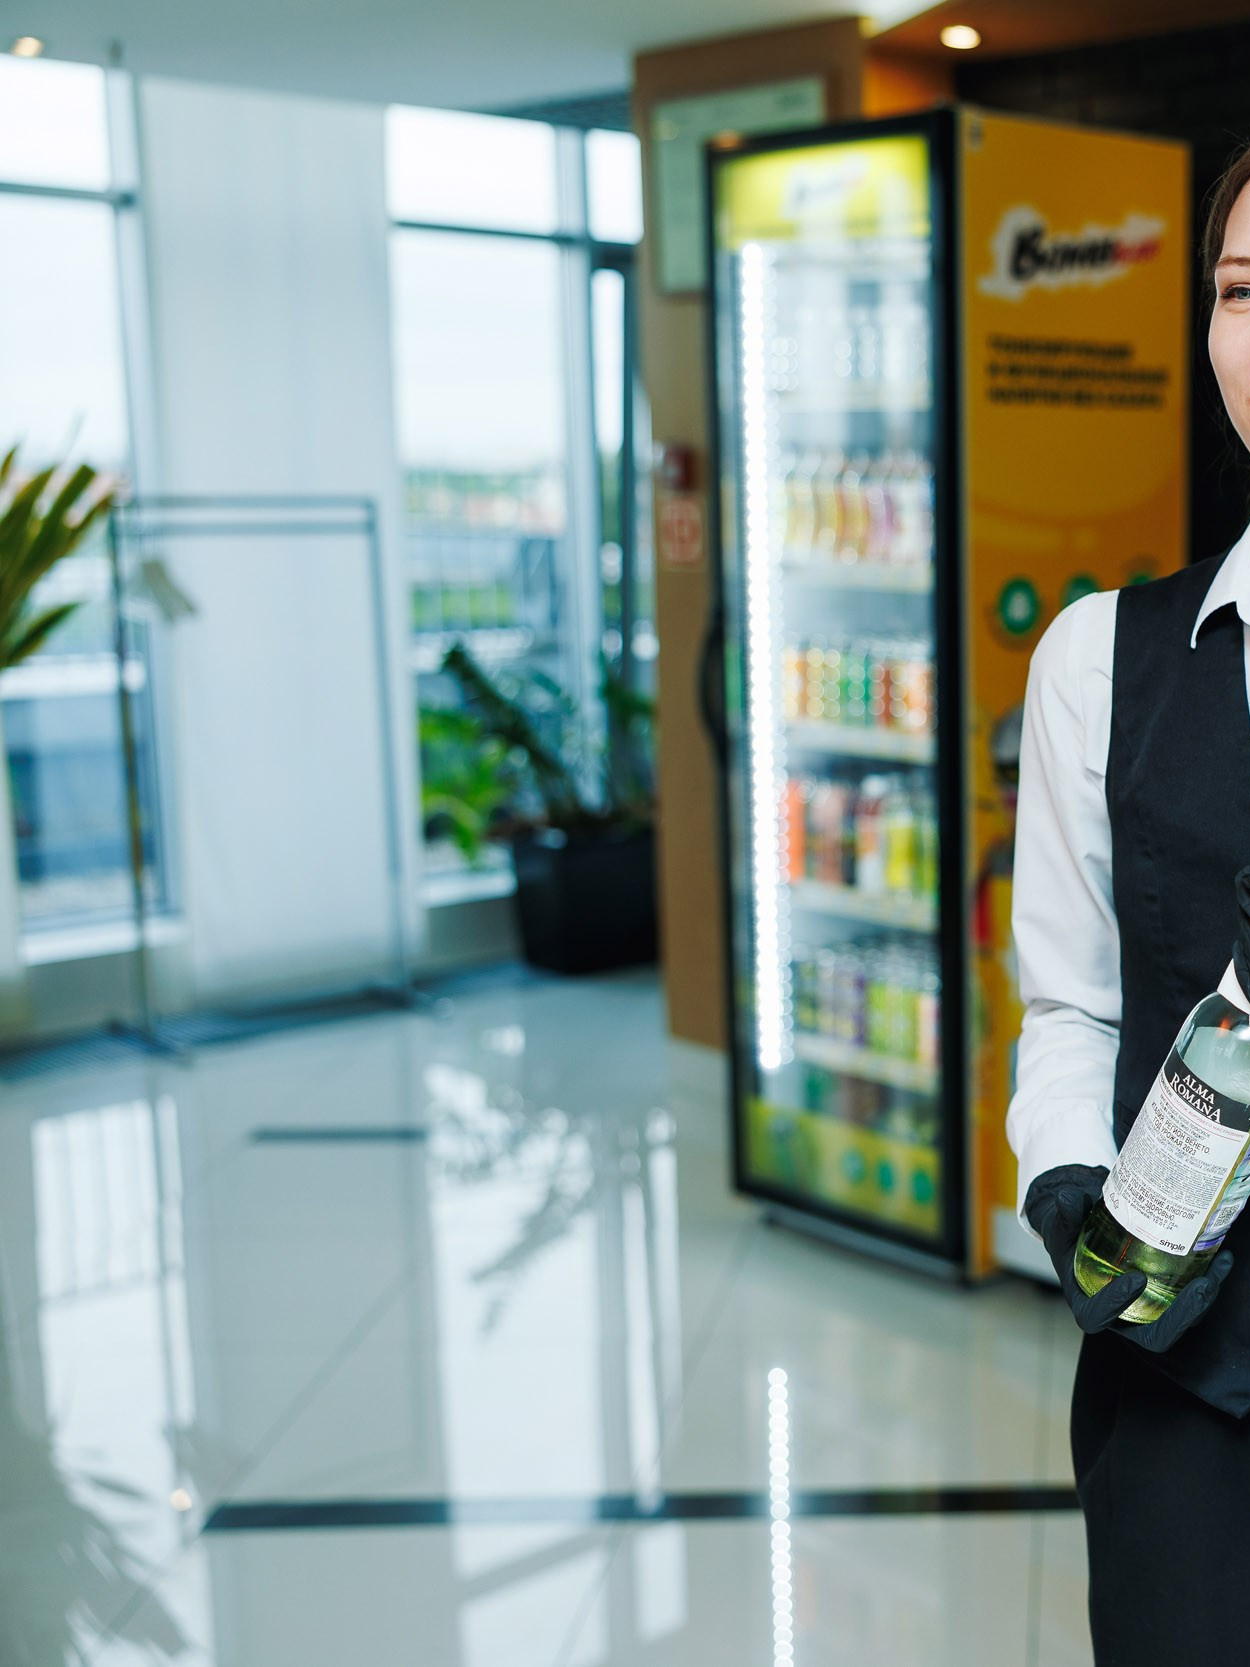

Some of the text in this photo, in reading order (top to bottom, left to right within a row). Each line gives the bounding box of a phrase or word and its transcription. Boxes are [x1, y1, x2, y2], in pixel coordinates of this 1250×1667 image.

[1170, 1072, 1221, 1124] ROMANA
[1182, 1074, 1215, 1105] ALMA
[1153, 1116, 1162, 1131] ГОД
[1160, 1127, 1183, 1148] УРОЖАЯ
[1182, 1143, 1197, 1156] 2023
[1165, 1119, 1186, 1140] РЕГИОН
[1129, 1178, 1195, 1220] УПОТРЕБЛЕНИЕ АЛКОГОЛЯ
[1159, 1238, 1186, 1251] simple
